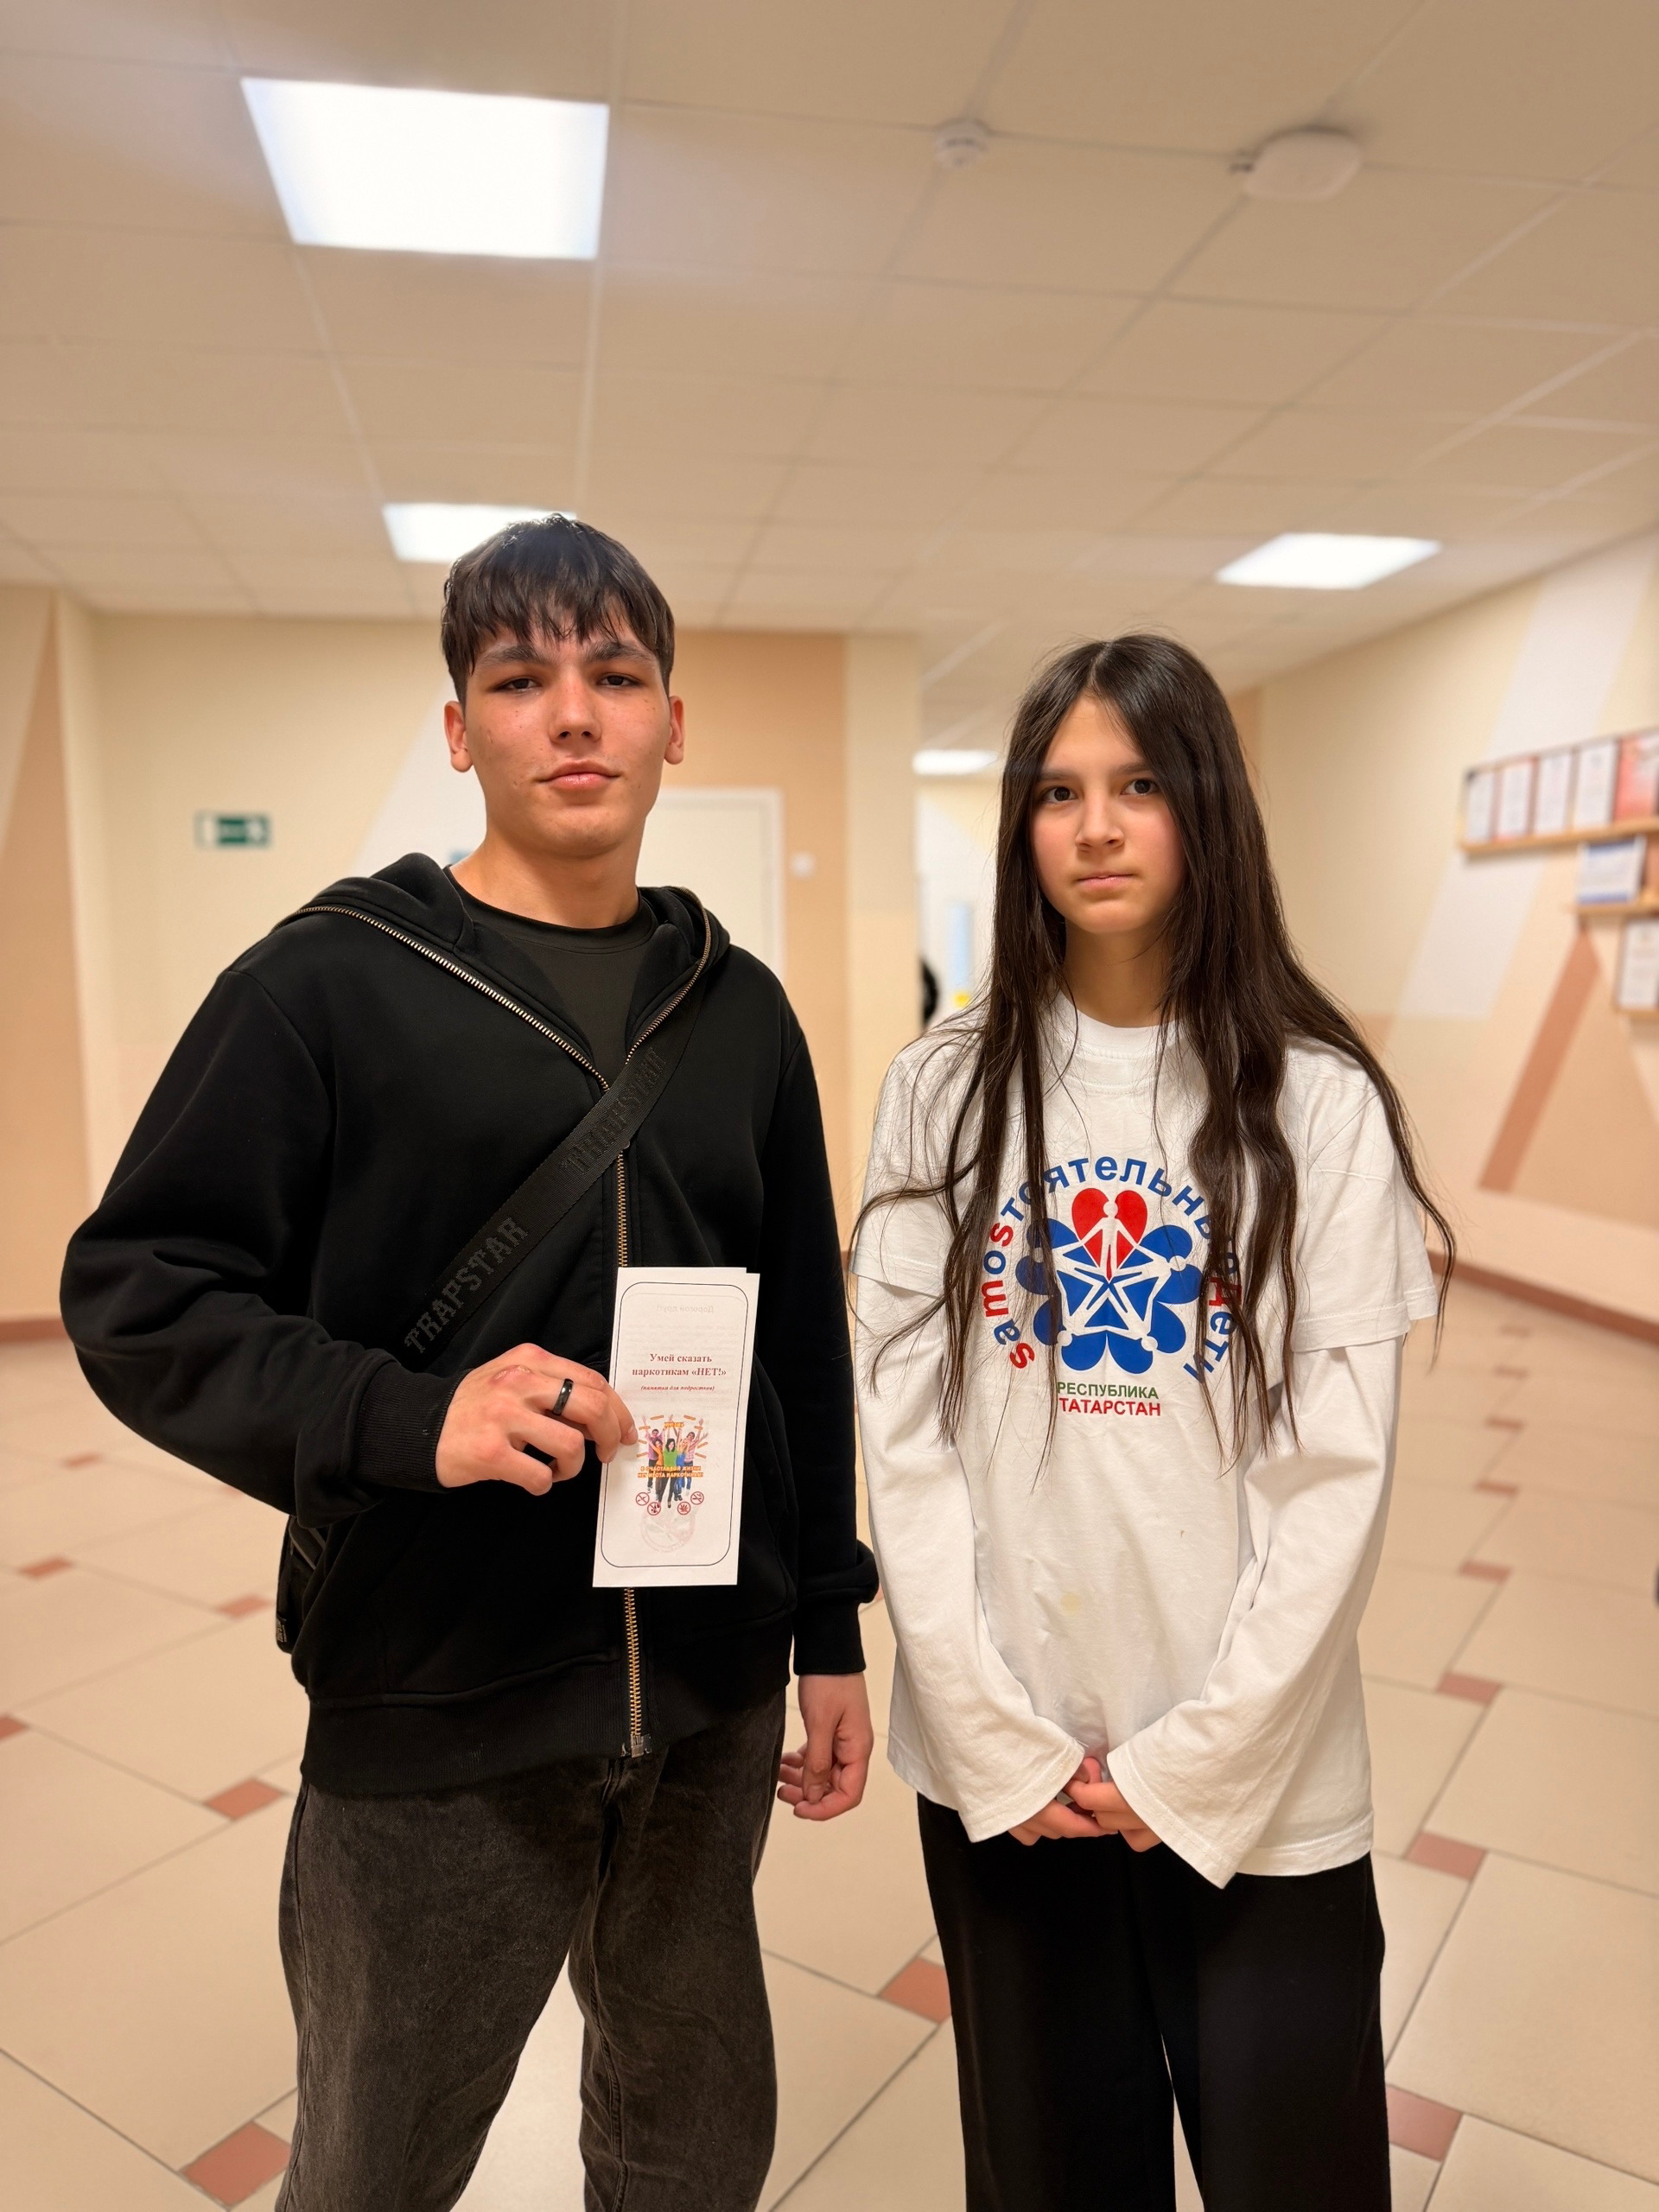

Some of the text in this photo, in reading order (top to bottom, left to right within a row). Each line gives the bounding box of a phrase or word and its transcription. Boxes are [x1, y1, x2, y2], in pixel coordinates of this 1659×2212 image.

[404, 1217, 529, 1354] TRAPSTAR
[650, 1353, 674, 1363] Умей
[632, 1368, 727, 1377] наркотикам «НЕТ!»
[1057, 1382, 1160, 1400] РЕСПУБЛИКА
[1058, 1398, 1161, 1416] ТАТАРСТАН
